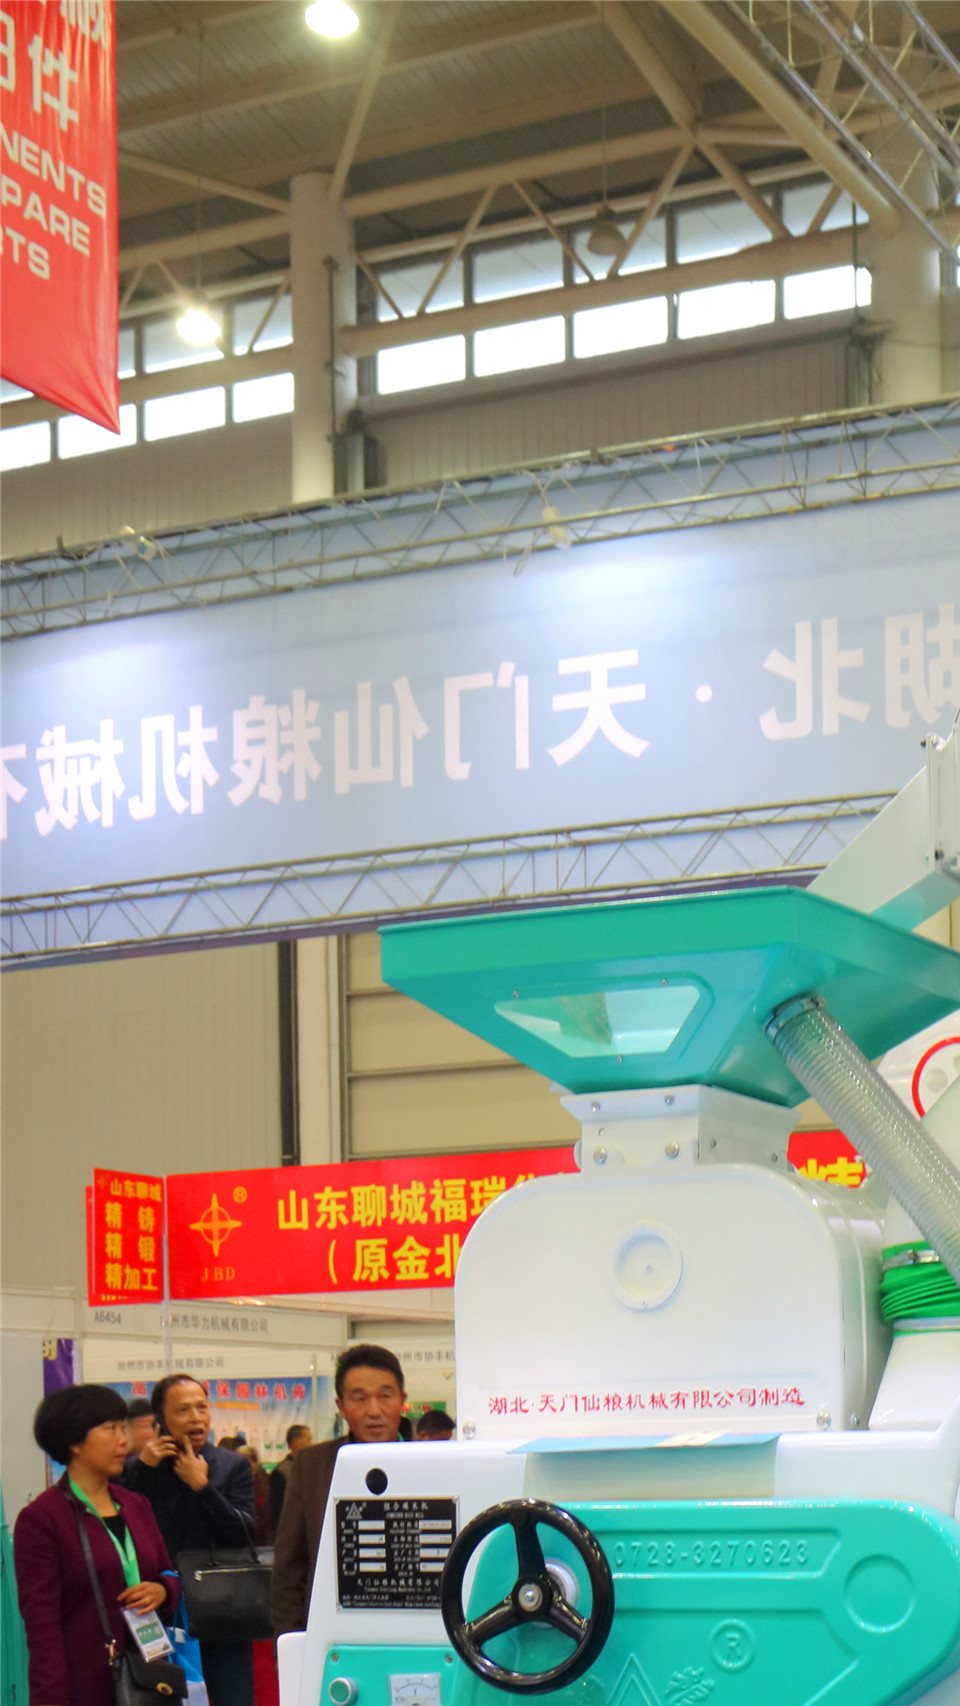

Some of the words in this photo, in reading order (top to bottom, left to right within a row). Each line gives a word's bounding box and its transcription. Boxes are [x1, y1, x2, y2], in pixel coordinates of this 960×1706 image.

[0, 221, 50, 280] TS
[110, 1178, 161, 1202] 山东聊城
[105, 1261, 157, 1291] 精加工
